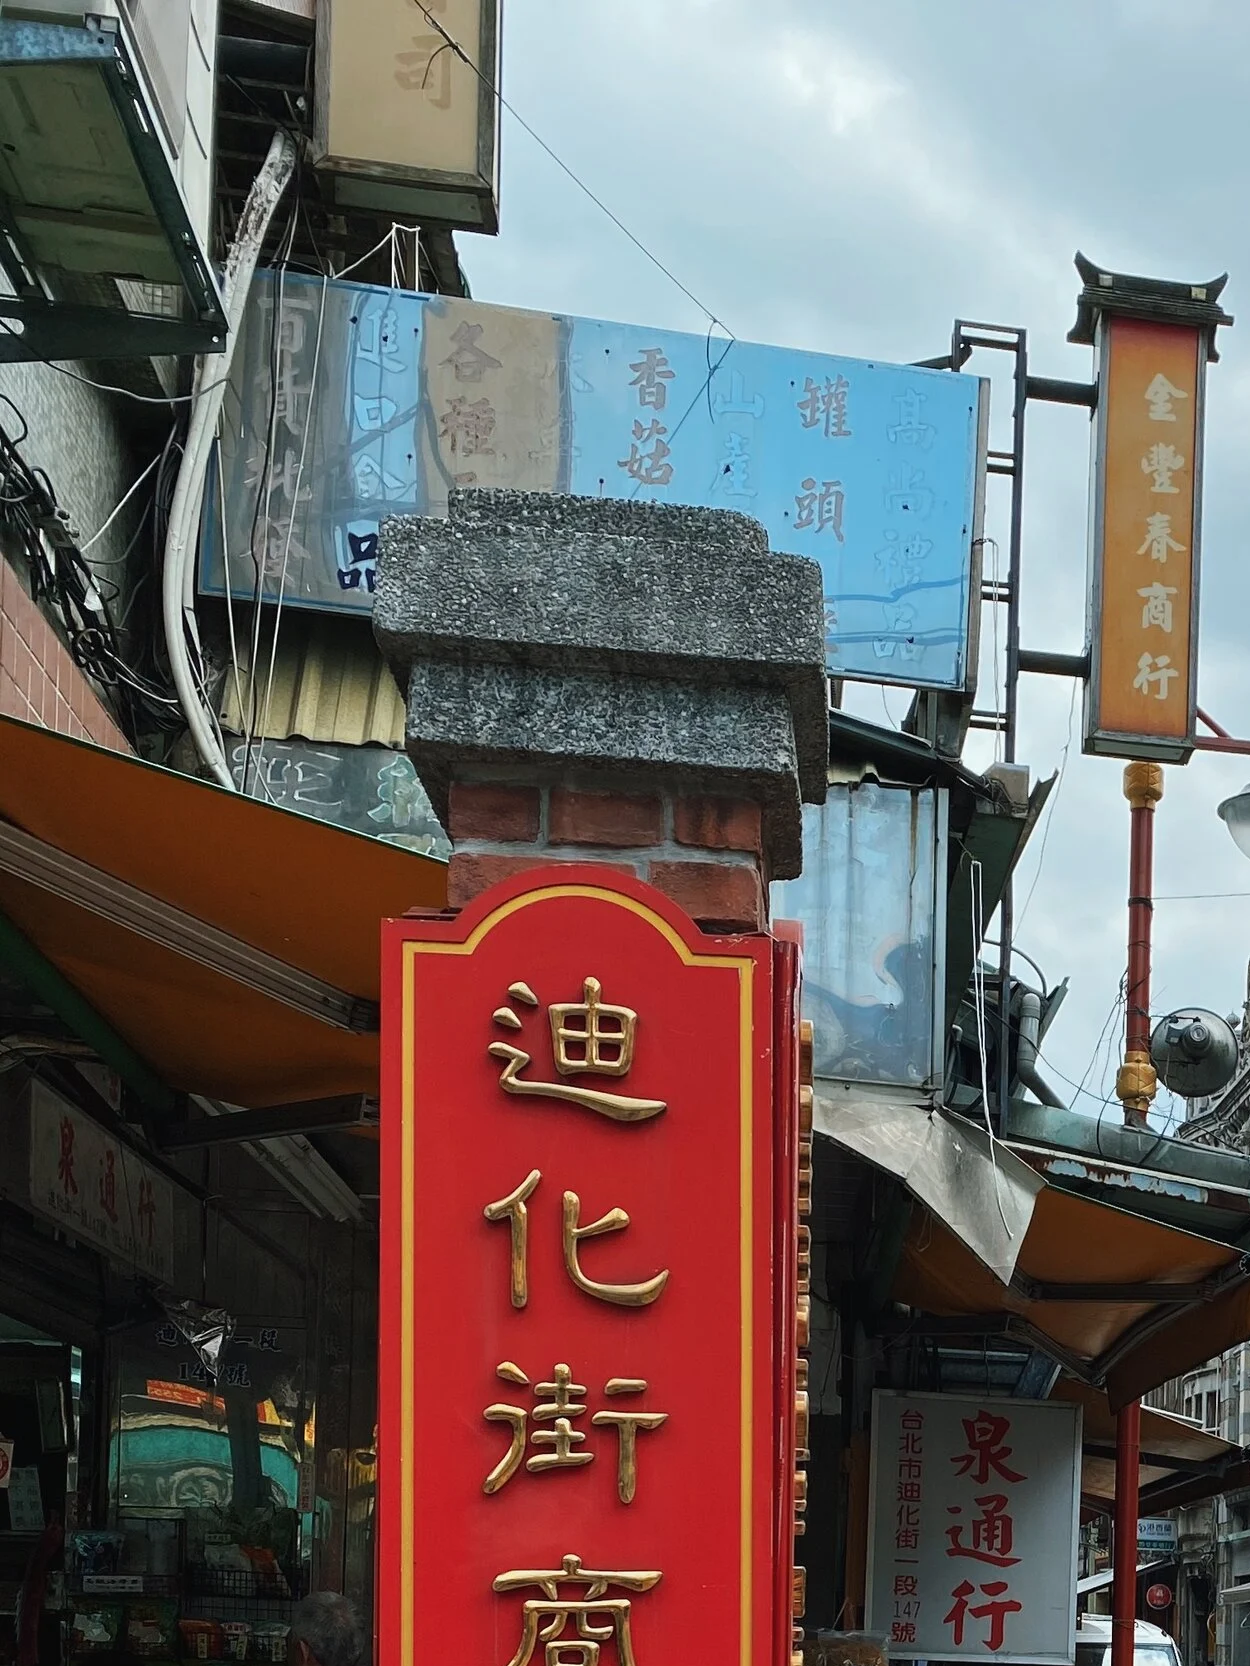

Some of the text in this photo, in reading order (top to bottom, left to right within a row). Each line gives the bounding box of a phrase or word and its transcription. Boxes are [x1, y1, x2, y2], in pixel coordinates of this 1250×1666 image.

[617, 347, 675, 485] 香菇
[1132, 372, 1189, 700] 金豐春商行
[890, 1408, 924, 1644] 台北市迪化街一段147號
[942, 1408, 1029, 1652] 泉通行
